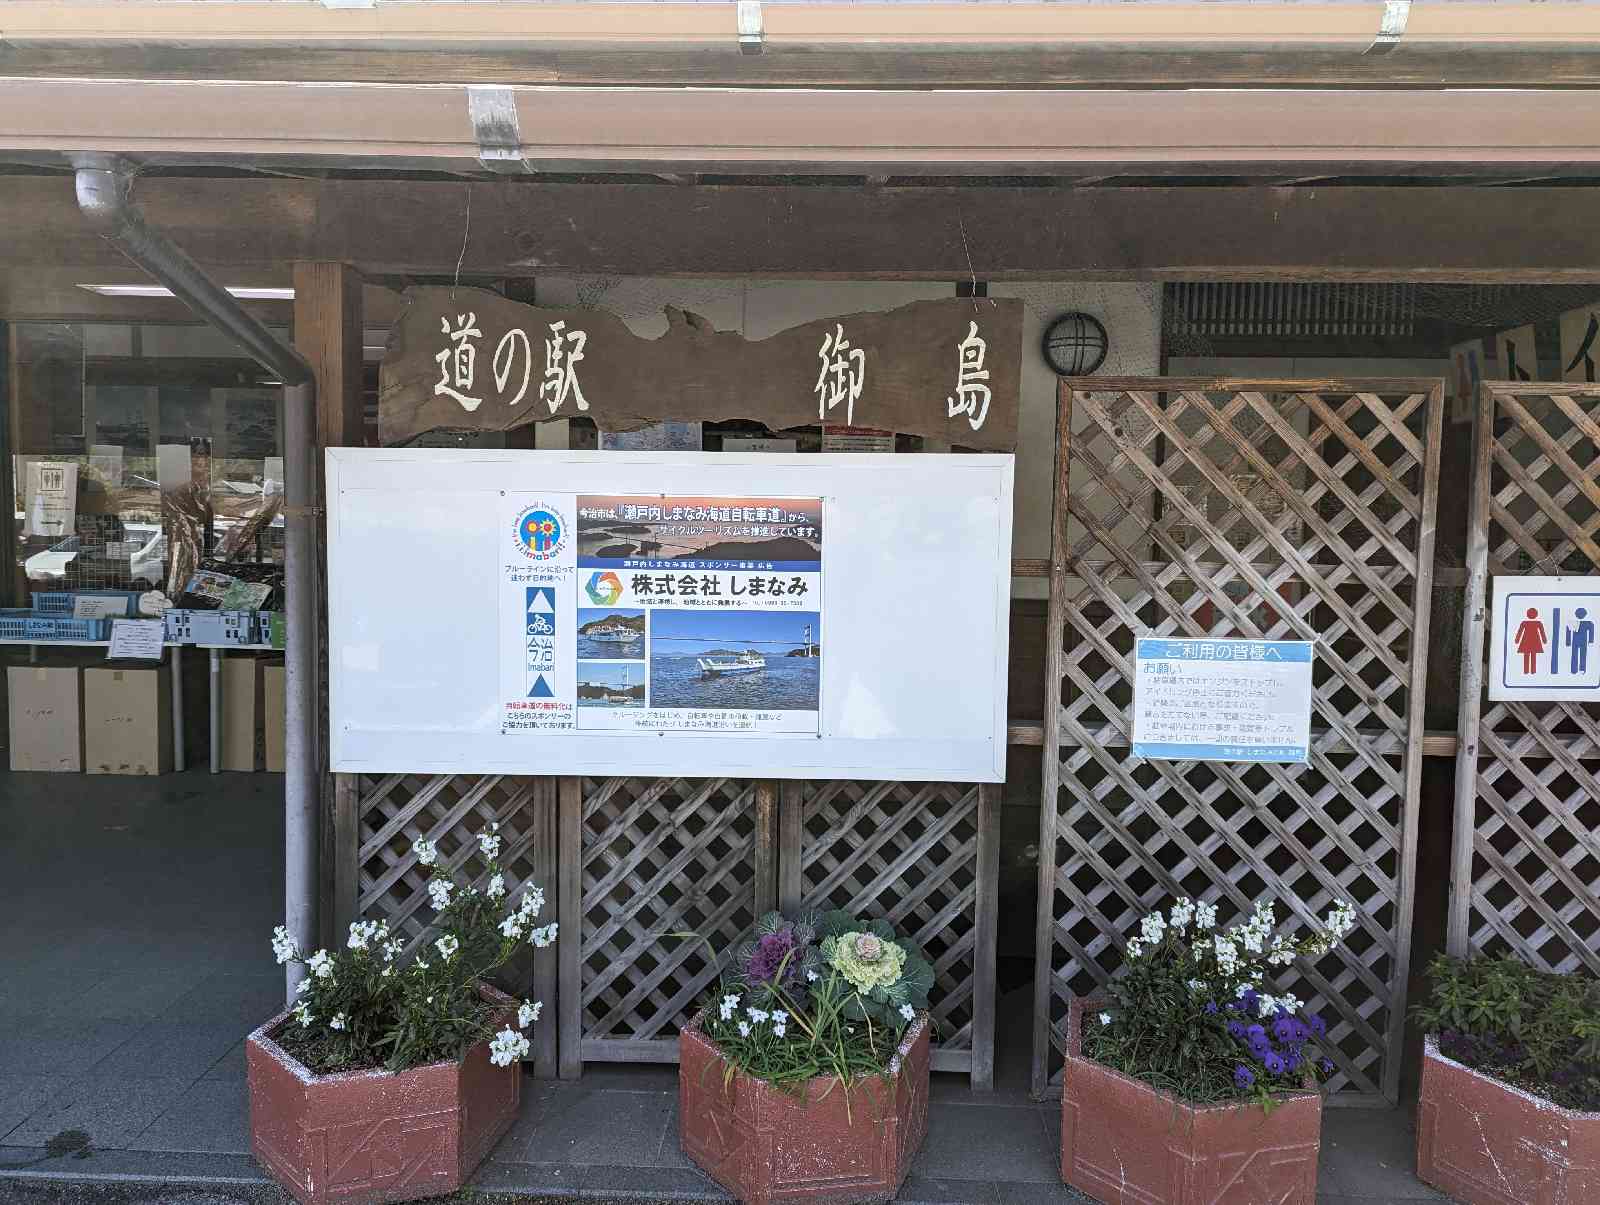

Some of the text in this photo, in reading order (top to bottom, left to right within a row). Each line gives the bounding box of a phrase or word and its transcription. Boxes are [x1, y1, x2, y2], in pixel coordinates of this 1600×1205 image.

[434, 312, 590, 414] 道の駅
[632, 573, 809, 596] 株式会社 しまなみ
[527, 637, 553, 662] 今治
[1166, 642, 1282, 660] ご利用の皆様へ
[1143, 662, 1183, 675] お願い
